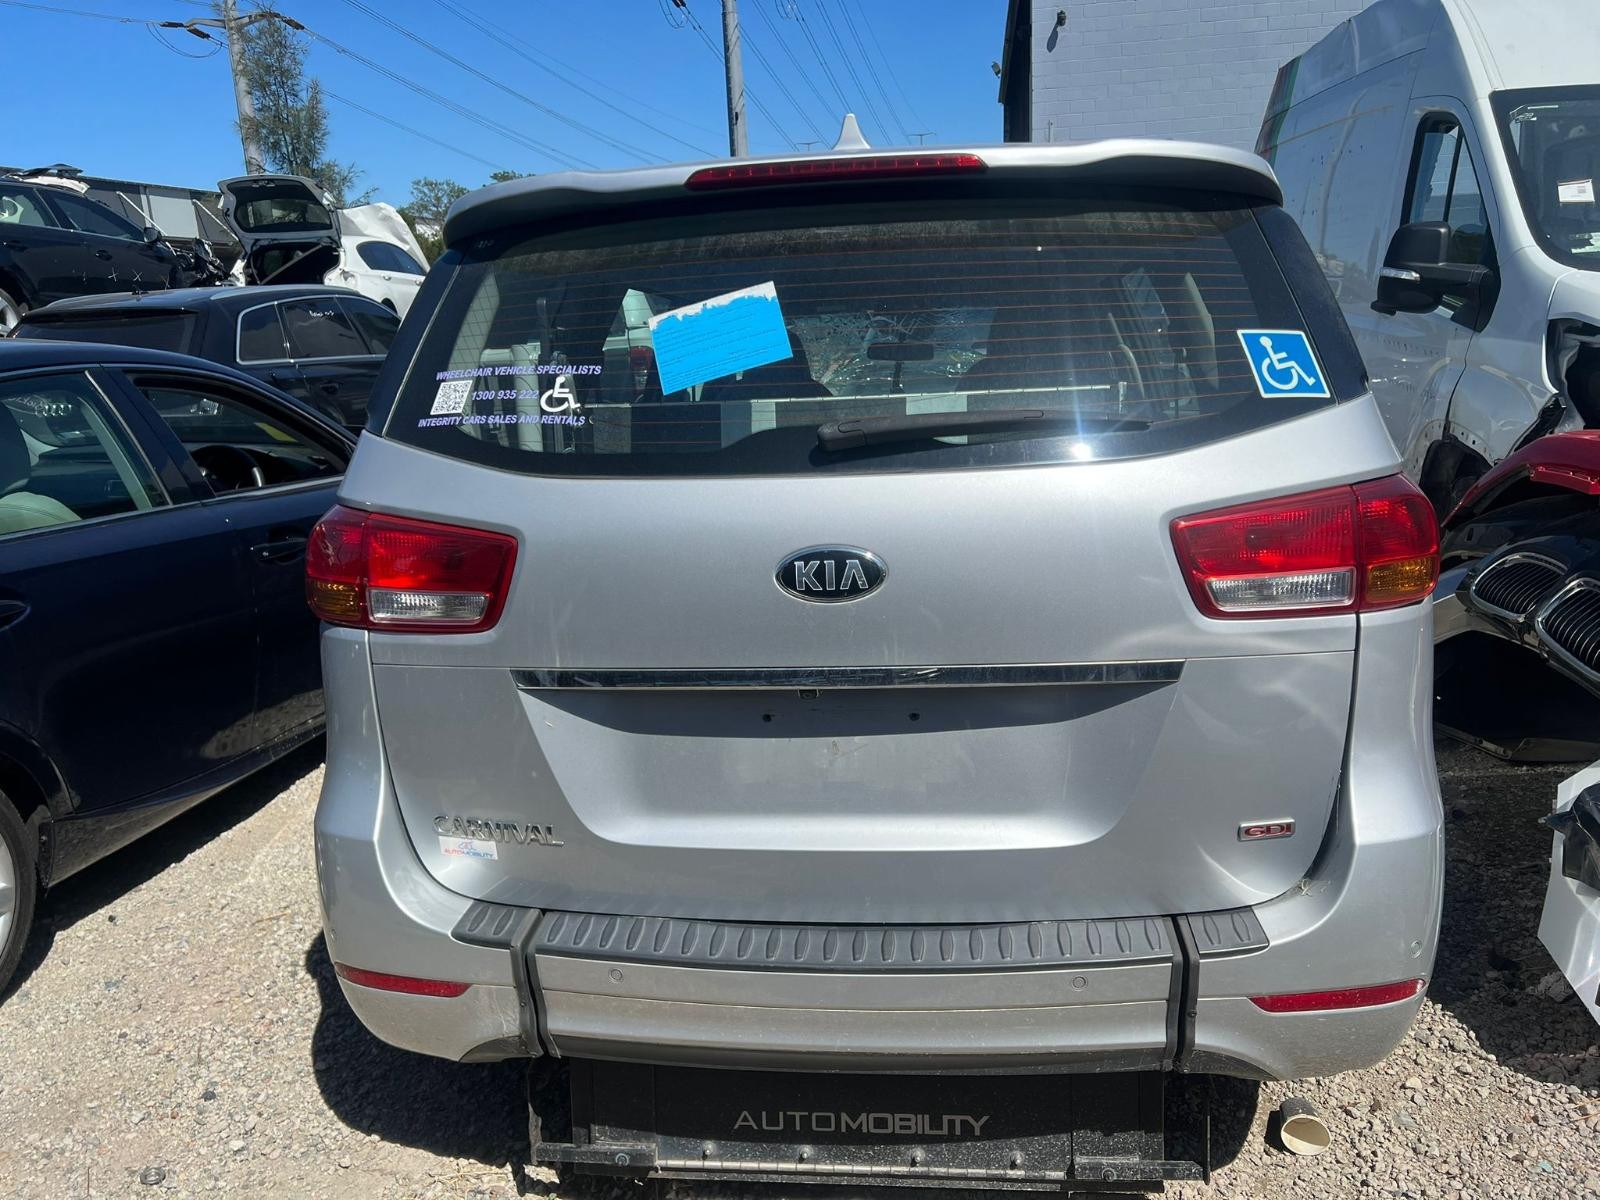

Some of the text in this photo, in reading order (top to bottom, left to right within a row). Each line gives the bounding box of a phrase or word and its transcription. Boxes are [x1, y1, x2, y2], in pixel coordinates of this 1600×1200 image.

[435, 365, 602, 381] WHEELCHAIR VEHICLE SPECIALISTS
[472, 389, 540, 400] 1300 935 222
[417, 414, 586, 427] INTEGRITY CARS SALES AND RENTALS
[794, 559, 869, 591] KIA
[433, 815, 565, 847] CARNIVAL
[1244, 823, 1292, 837] GDI
[733, 1110, 991, 1137] AUTOMOBILITY
